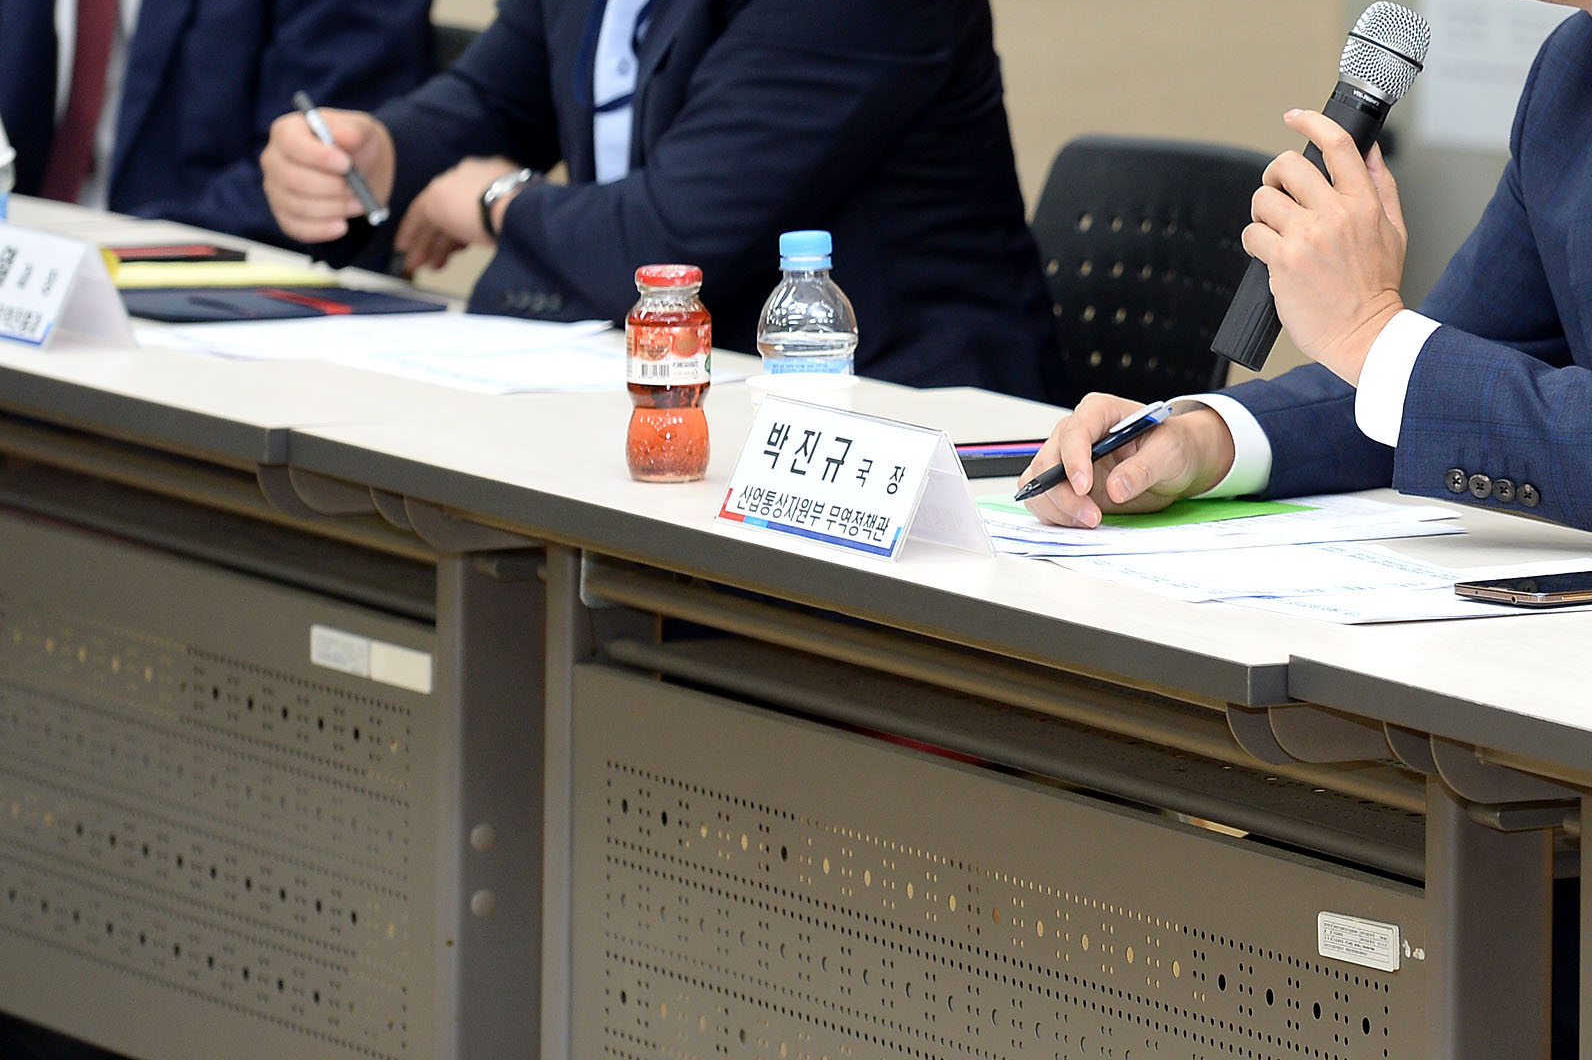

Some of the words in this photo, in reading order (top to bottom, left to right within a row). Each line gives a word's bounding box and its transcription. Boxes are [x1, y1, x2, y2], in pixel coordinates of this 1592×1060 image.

[763, 421, 853, 484] 박진규
[736, 484, 826, 527] 산업통상자원부
[826, 505, 891, 542] 무역정책관
